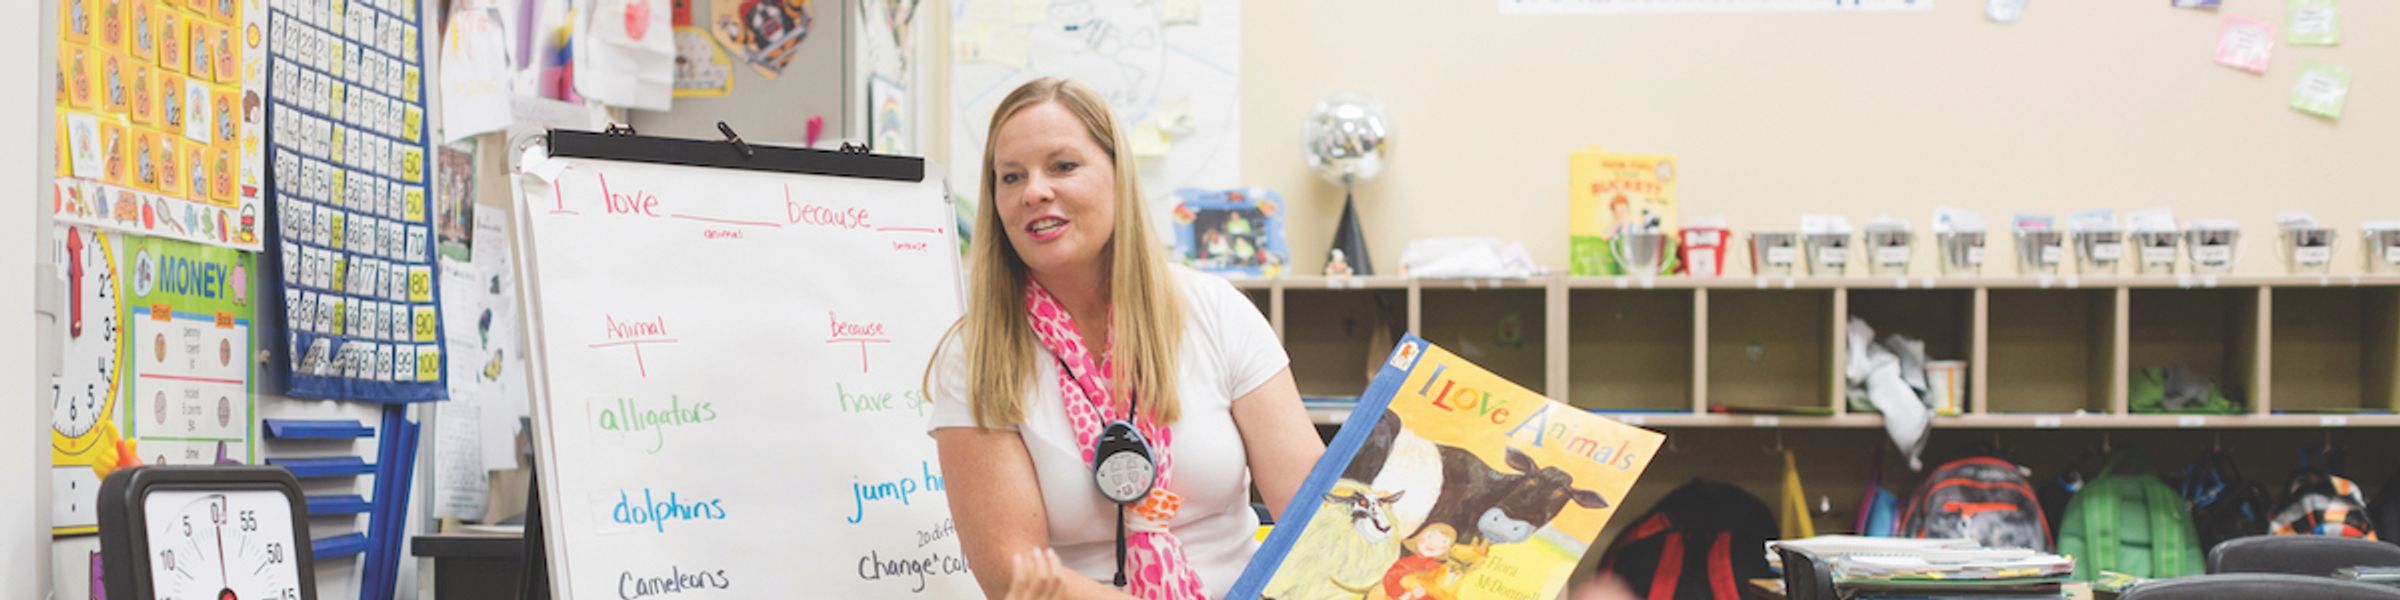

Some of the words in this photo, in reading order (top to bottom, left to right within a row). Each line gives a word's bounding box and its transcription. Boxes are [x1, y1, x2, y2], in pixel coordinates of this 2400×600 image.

[170, 106, 181, 127] 22
[405, 151, 421, 175] 50
[405, 192, 421, 216] 60
[549, 166, 580, 216] I
[599, 172, 661, 219] love
[784, 182, 872, 230] because
[410, 232, 425, 256] 70
[703, 228, 744, 240] animal
[99, 273, 106, 298] 2
[159, 253, 228, 300] MONEY
[411, 272, 430, 296] 80
[104, 316, 112, 342] 3
[415, 312, 433, 336] 90
[605, 312, 667, 339] Animal
[97, 355, 105, 381] 4
[396, 350, 413, 374] 99
[418, 351, 438, 374] 100
[69, 395, 78, 422] 6
[87, 384, 95, 409] 5
[835, 381, 894, 414] have
[599, 393, 718, 455] alligators
[1417, 362, 1449, 399] I
[1503, 402, 1637, 473] Animals
[612, 486, 727, 533] dolphins
[846, 473, 917, 525] jump
[210, 501, 220, 525] 0
[239, 509, 258, 532] 55
[182, 515, 193, 538] 5
[159, 548, 176, 572] 10
[266, 542, 284, 565] 50
[1486, 555, 1520, 577] Flora
